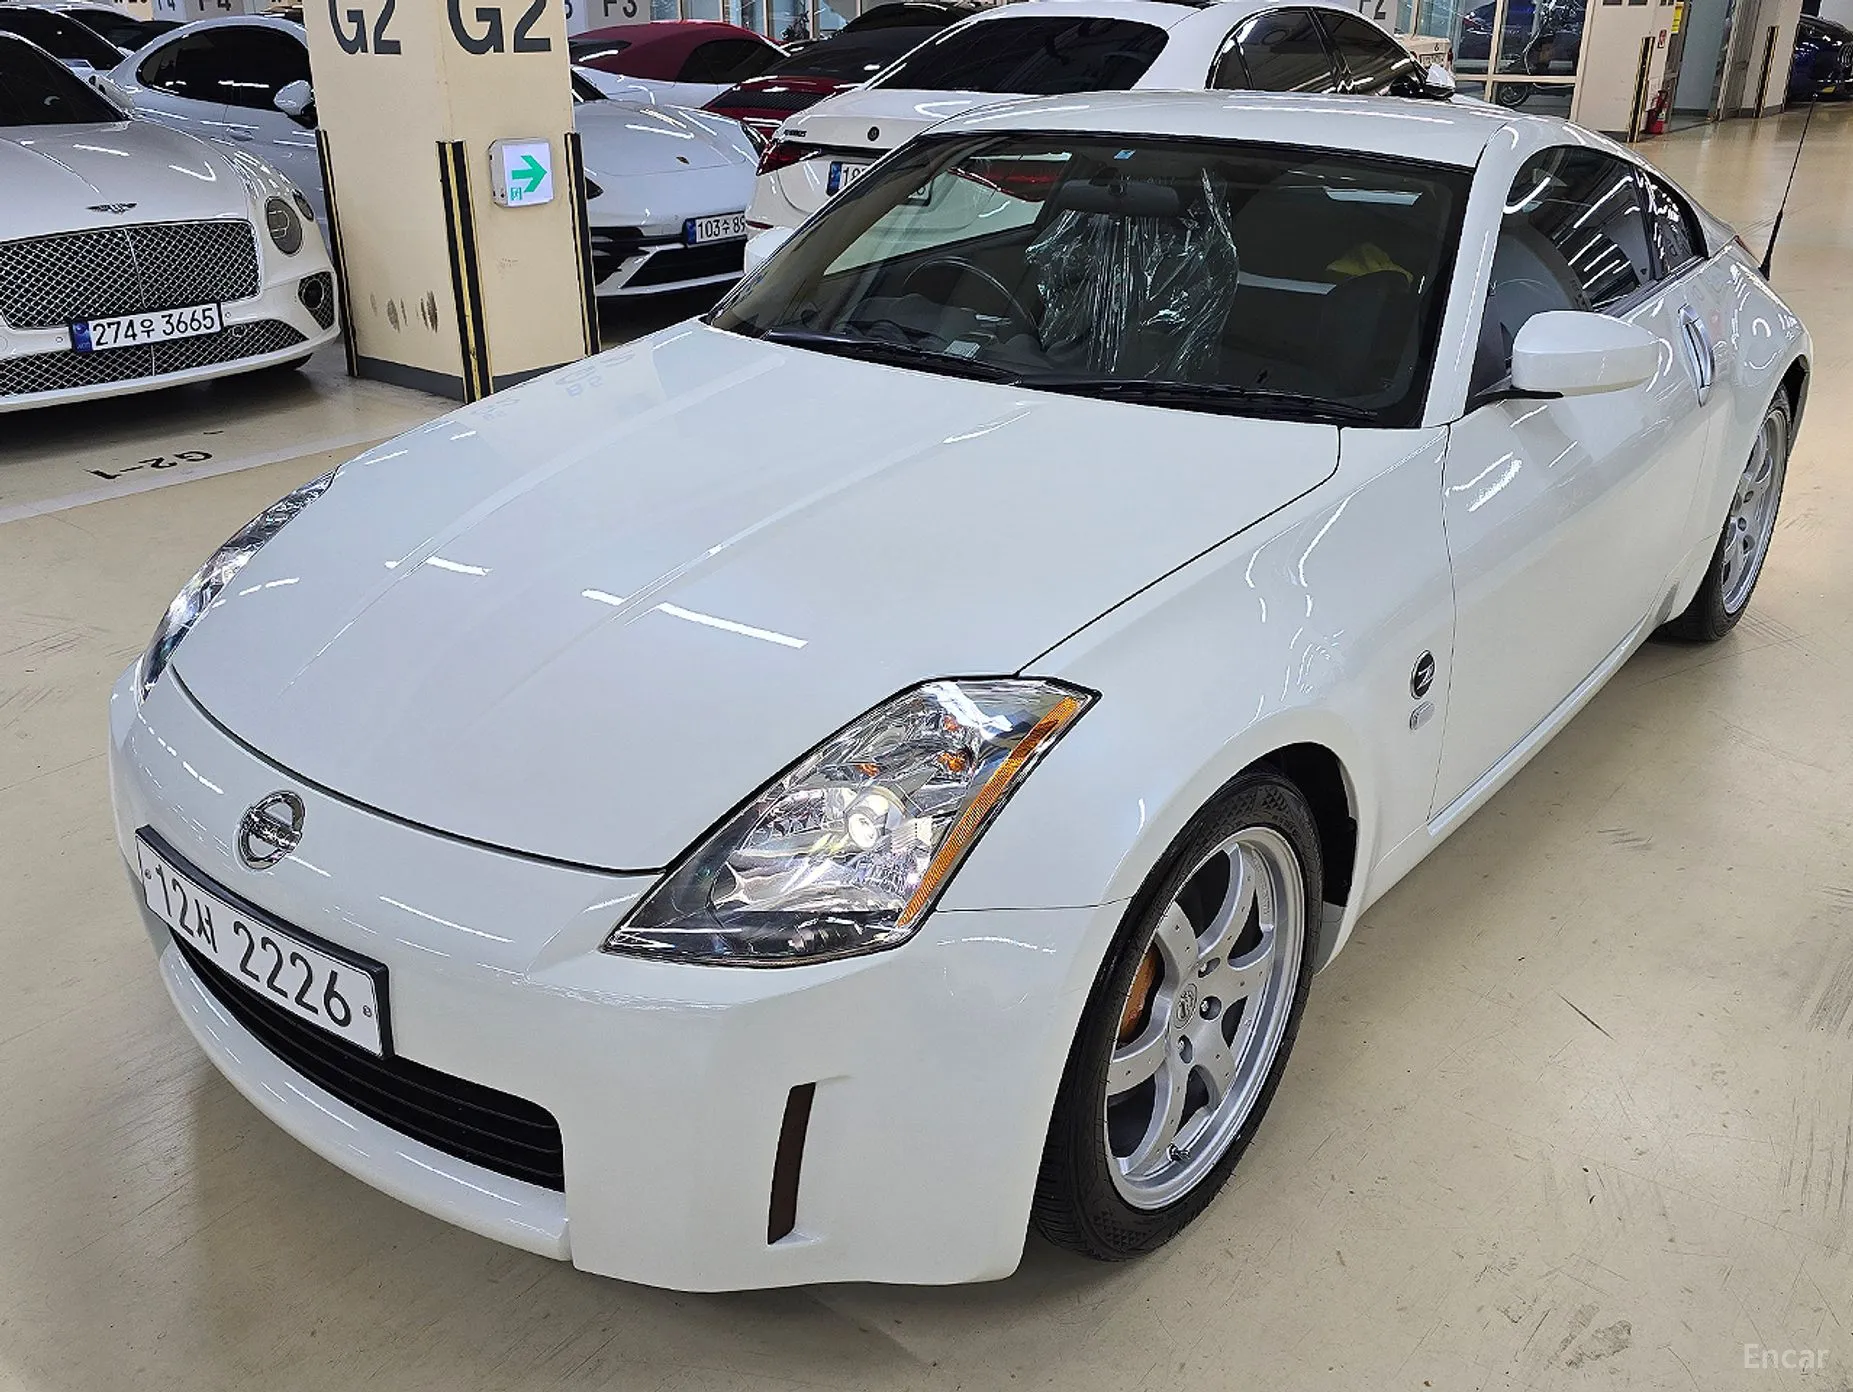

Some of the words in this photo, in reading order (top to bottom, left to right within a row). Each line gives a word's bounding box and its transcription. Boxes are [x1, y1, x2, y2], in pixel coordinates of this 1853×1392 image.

[327, 0, 402, 55] G2
[446, 0, 552, 55] G2
[92, 318, 155, 347] 274우
[160, 307, 215, 337] 3665
[84, 451, 213, 480] G2-1
[155, 864, 219, 954] 12서
[233, 920, 352, 1028] 2226
